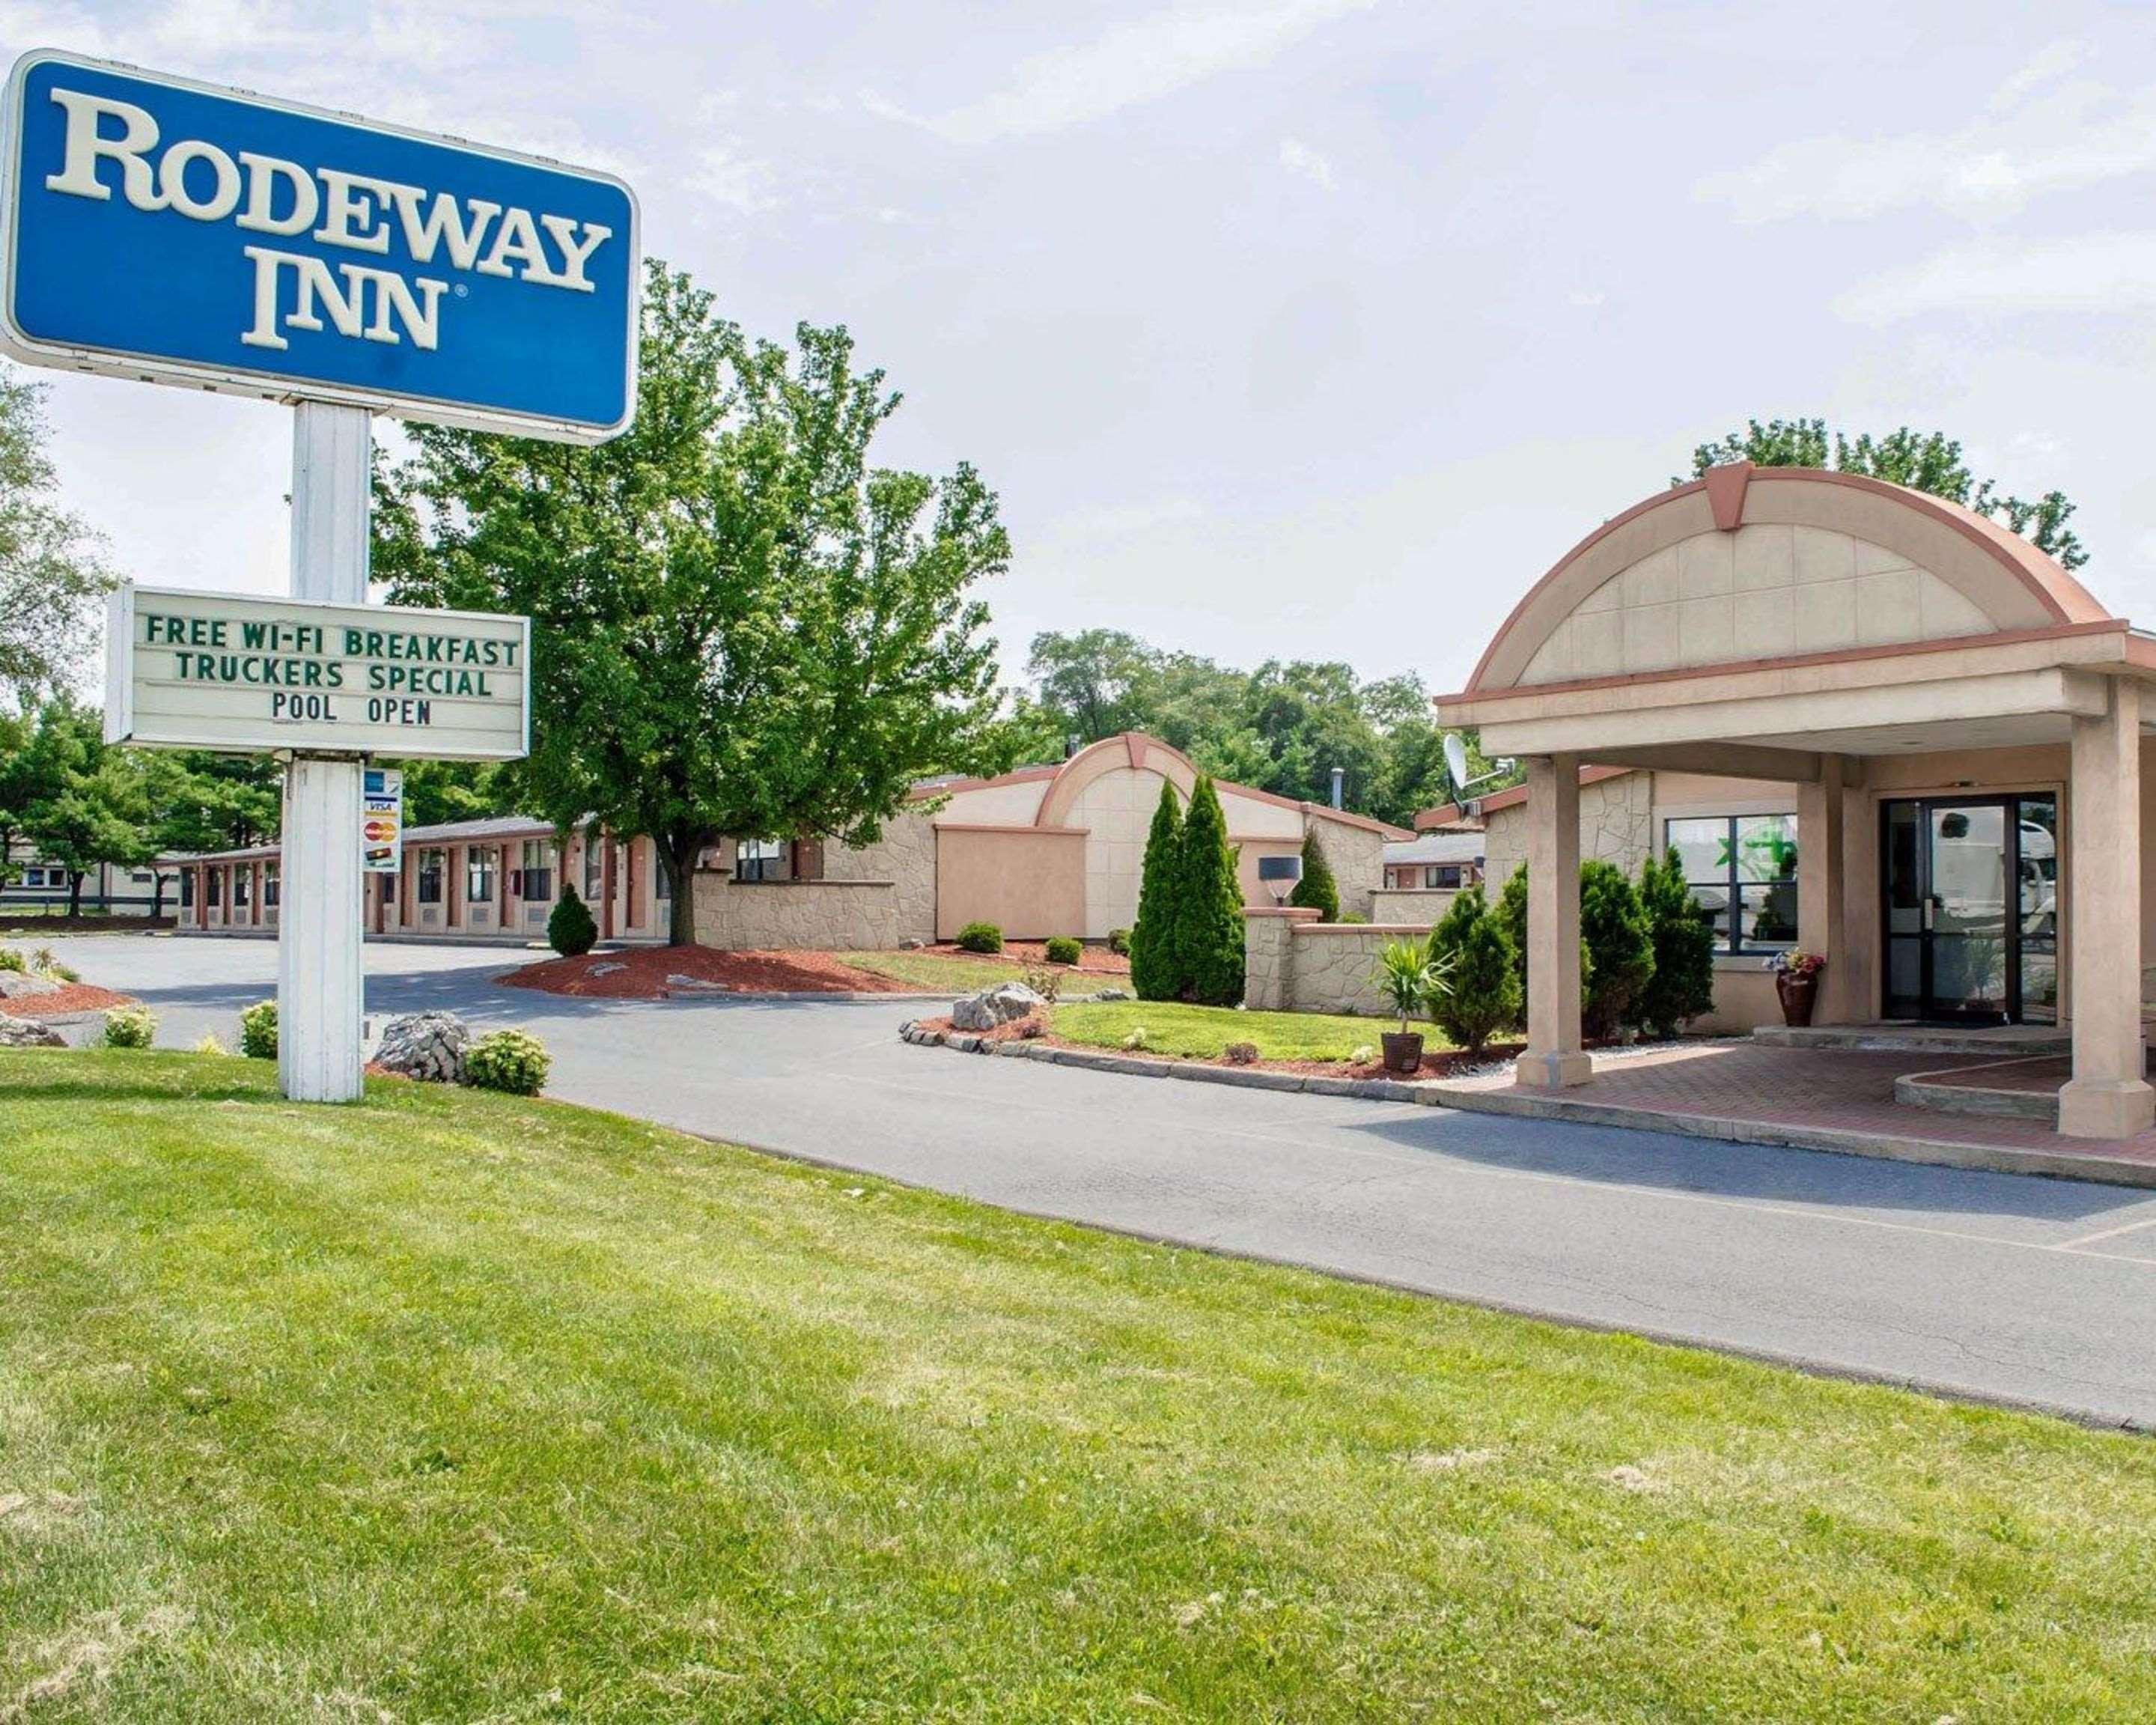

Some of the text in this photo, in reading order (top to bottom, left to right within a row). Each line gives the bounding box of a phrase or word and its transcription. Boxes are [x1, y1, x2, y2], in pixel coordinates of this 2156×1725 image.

[46, 88, 612, 293] RODEWAY
[241, 246, 448, 350] INN
[147, 616, 518, 666] FREE WI-FI BREAKFAST
[176, 653, 492, 696] TRUCKERS SPECIAL
[272, 693, 430, 725] POOL OPEN
